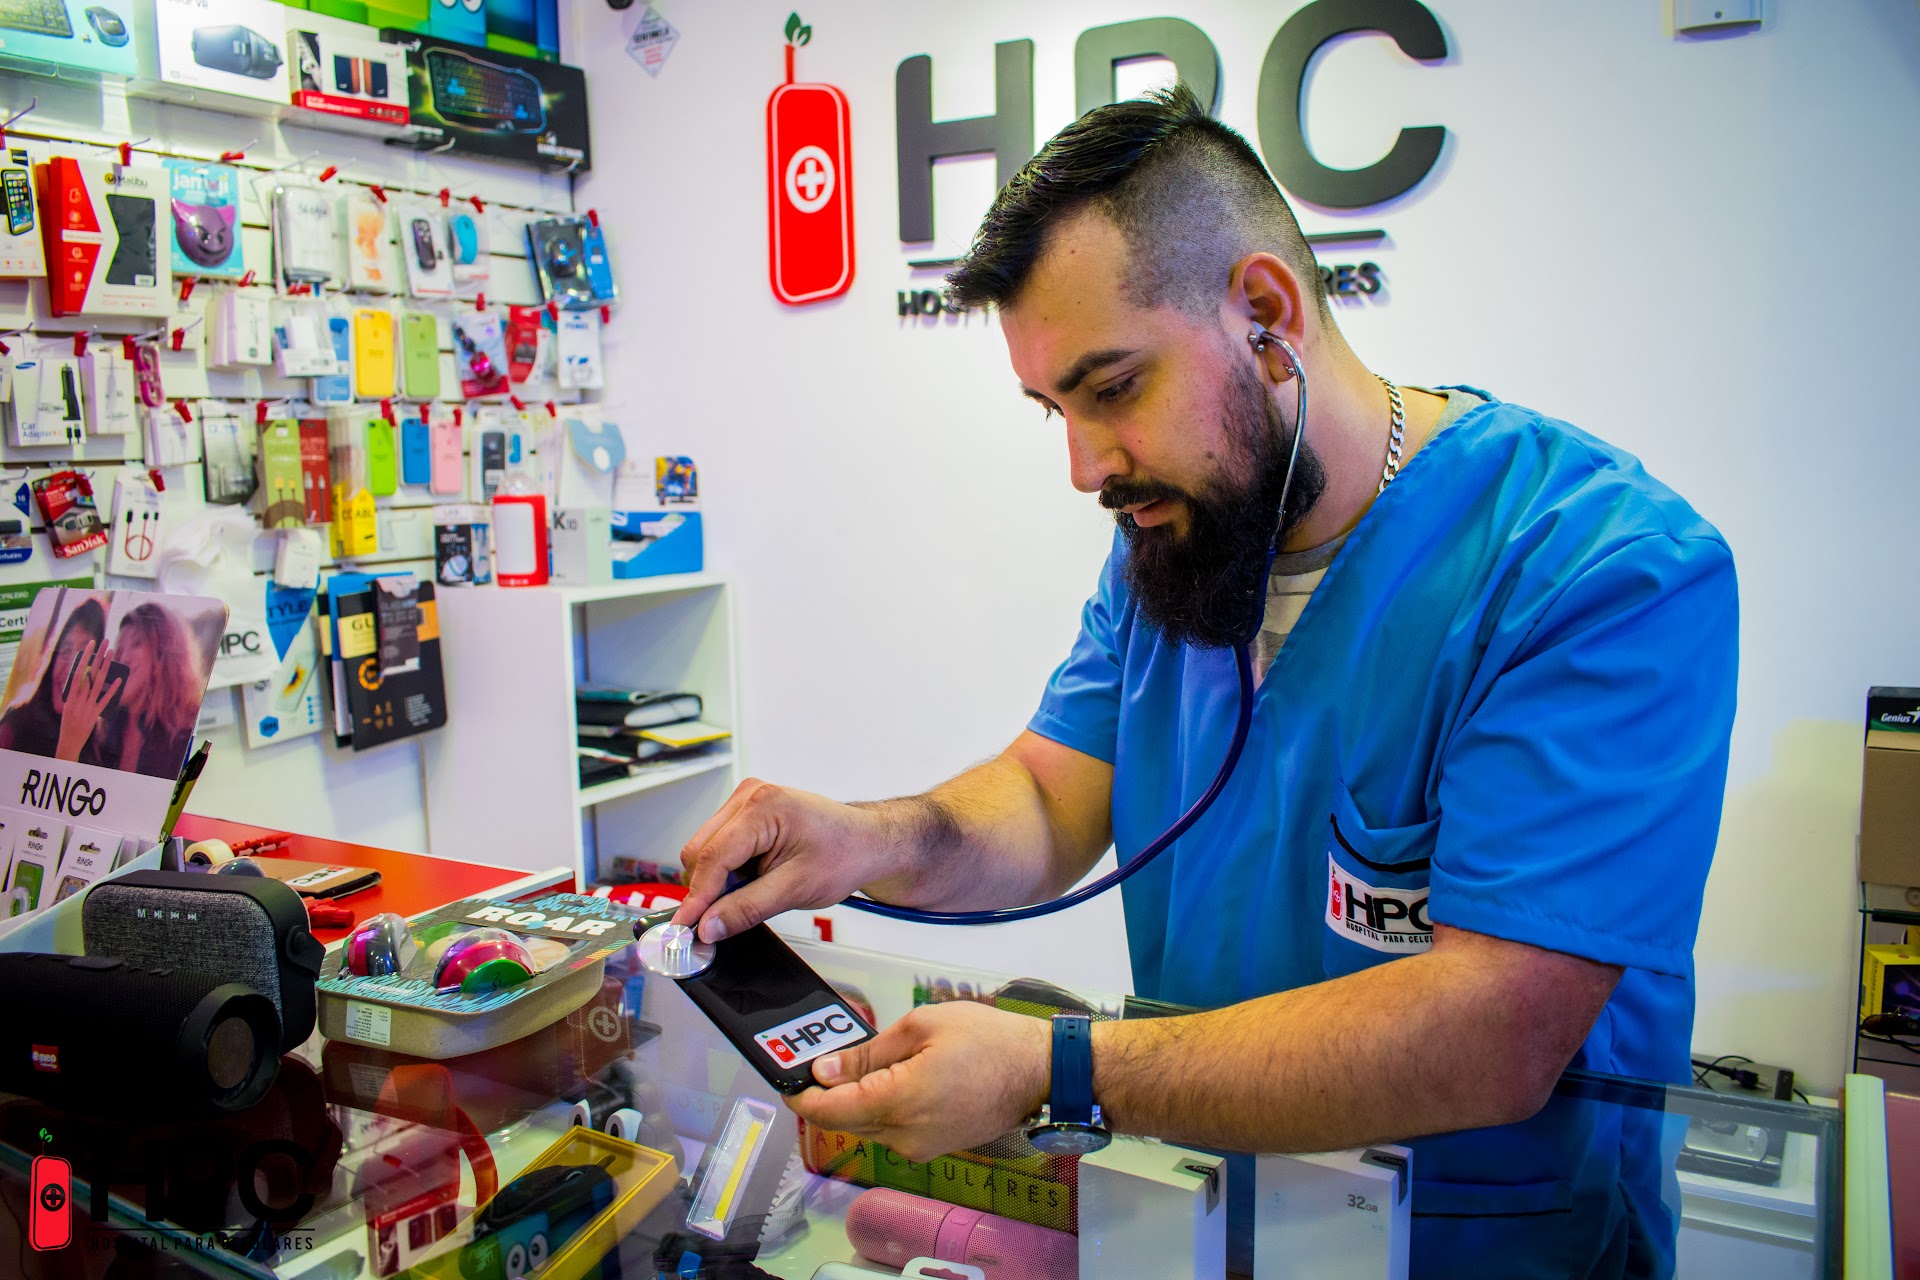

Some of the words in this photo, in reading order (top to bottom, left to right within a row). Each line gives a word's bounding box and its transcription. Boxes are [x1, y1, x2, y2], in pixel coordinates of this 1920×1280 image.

[63, 534, 104, 556] SanDisk
[1881, 713, 1911, 723] Genius
[465, 905, 617, 936] ROAR
[1346, 919, 1380, 942] HOSPITAL
[1383, 935, 1405, 943] PARA
[781, 1013, 853, 1053] HPC
